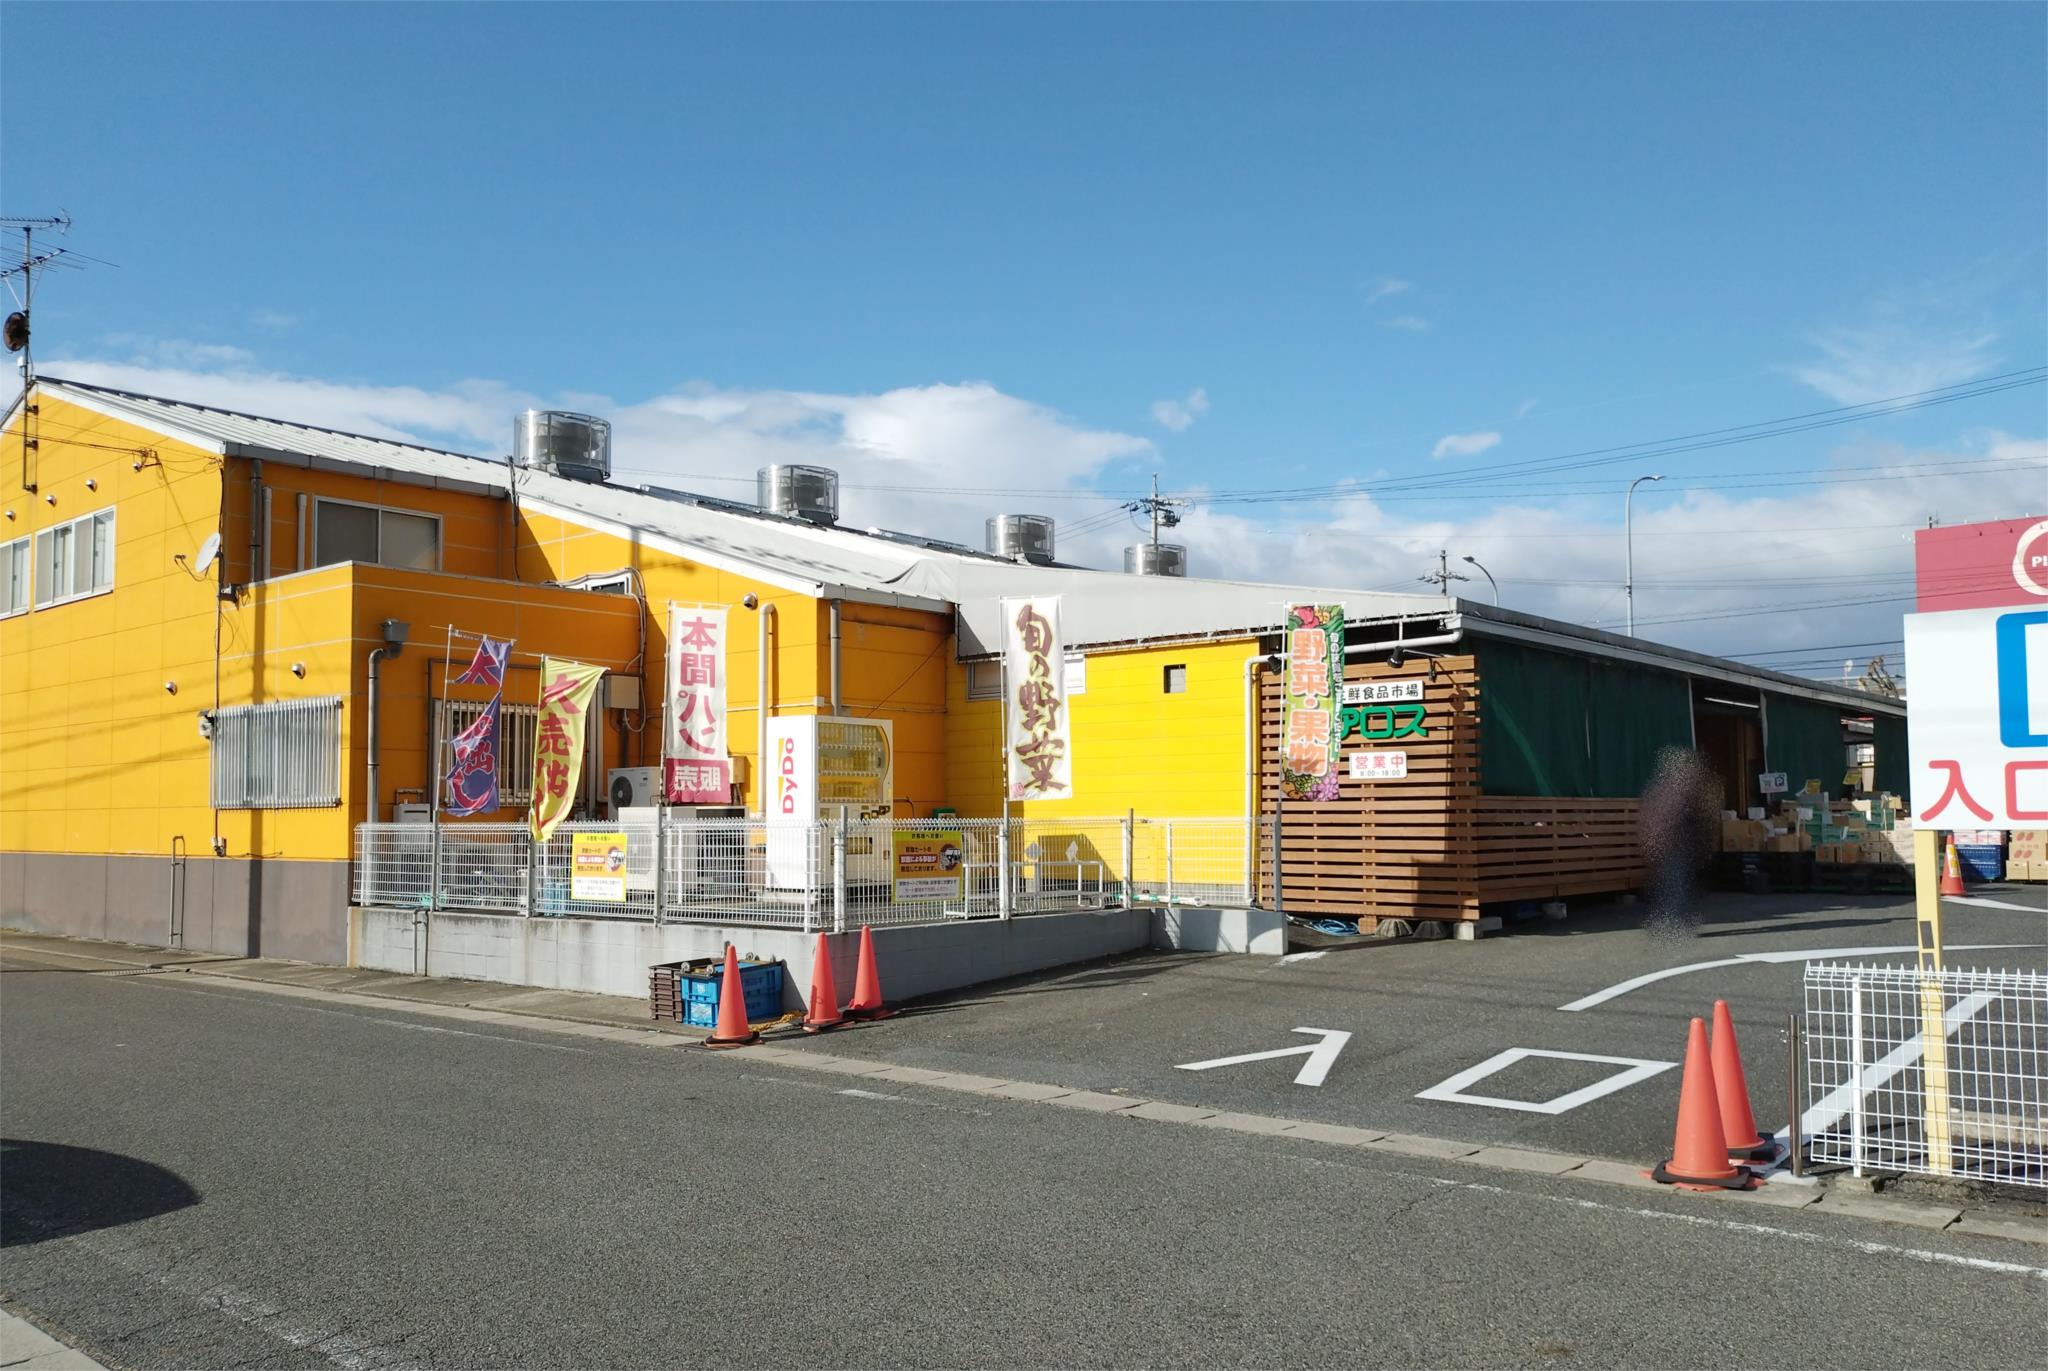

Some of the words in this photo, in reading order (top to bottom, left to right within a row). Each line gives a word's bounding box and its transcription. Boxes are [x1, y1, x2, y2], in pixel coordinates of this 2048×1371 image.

[1016, 604, 1068, 791] 旬の野菜
[1288, 630, 1330, 774] 野菜・果物
[1343, 683, 1419, 701] 鮮食品市場
[782, 738, 798, 814] DyDo
[1355, 755, 1404, 769] 営業中
